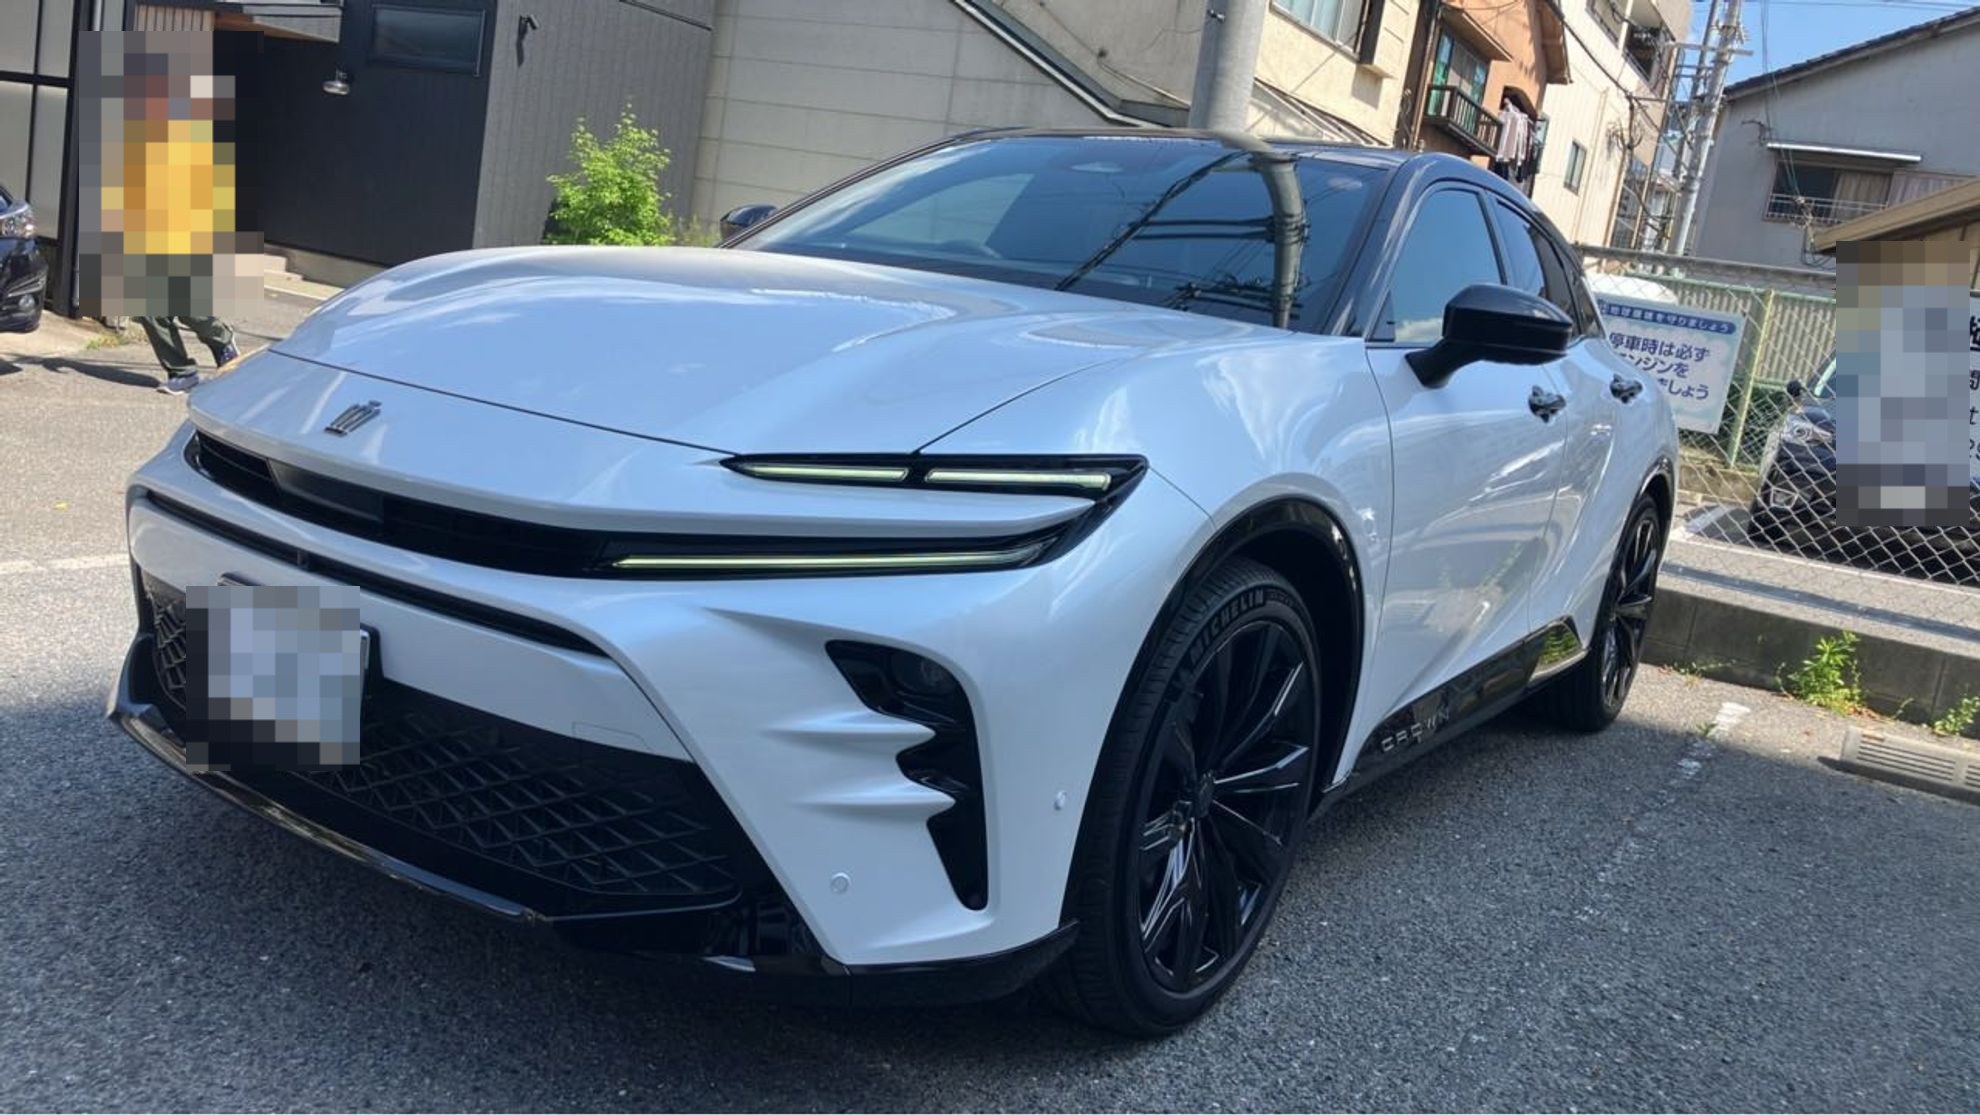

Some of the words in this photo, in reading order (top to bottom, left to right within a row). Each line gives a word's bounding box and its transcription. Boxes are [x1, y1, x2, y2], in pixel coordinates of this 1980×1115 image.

[1609, 332, 1709, 362] 停車時は必ず
[1189, 587, 1264, 665] MICHELIN
